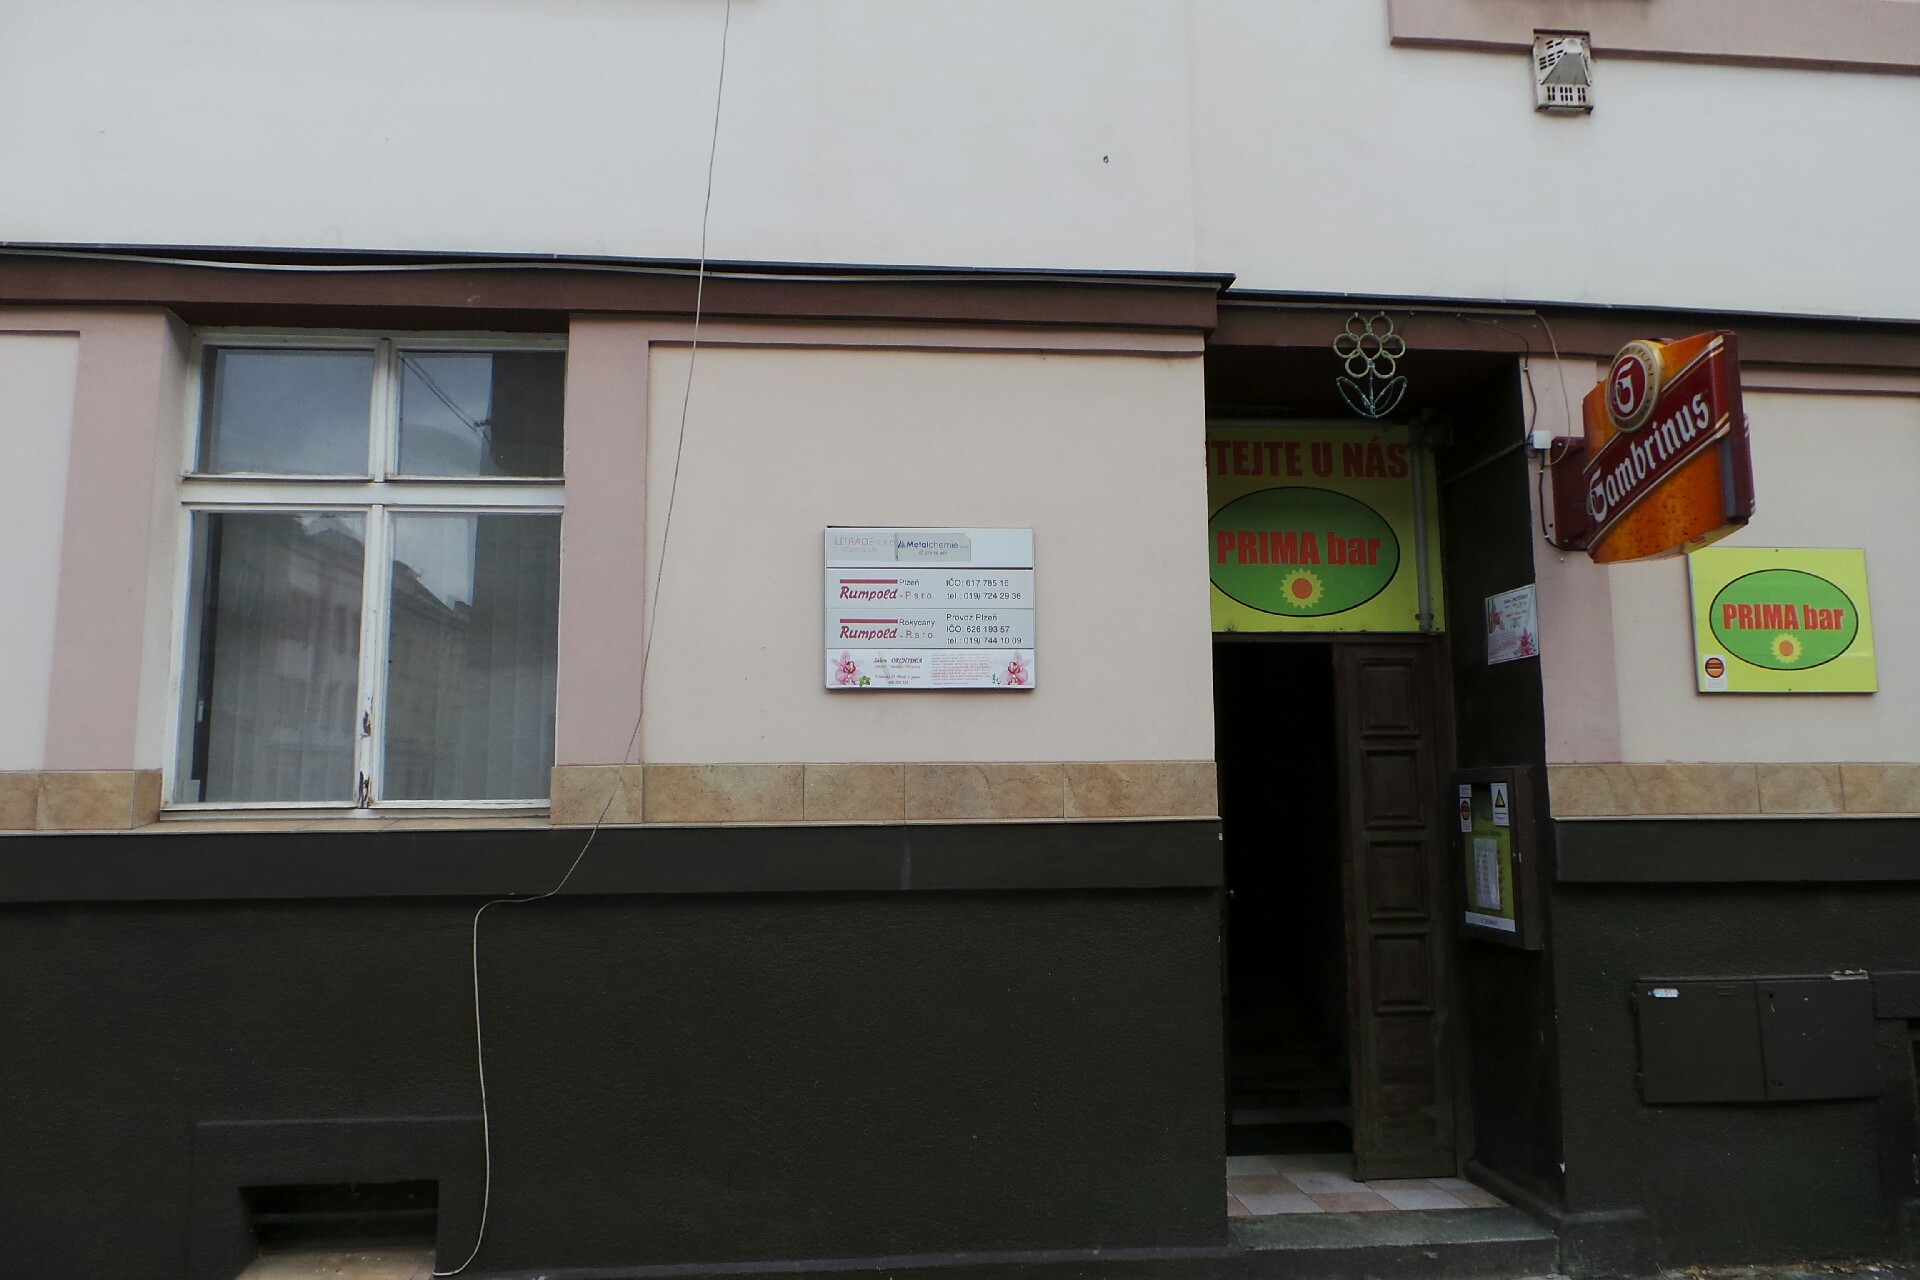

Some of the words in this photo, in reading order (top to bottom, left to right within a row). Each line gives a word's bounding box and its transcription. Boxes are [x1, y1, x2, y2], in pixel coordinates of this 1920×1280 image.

[1207, 440, 1303, 477] TEJTE
[1310, 442, 1334, 478] U
[1342, 436, 1409, 479] NÁS
[1587, 393, 1710, 523] Gambrinus
[906, 541, 959, 549] Metalchemie
[1217, 531, 1320, 565] PRIMA
[1327, 532, 1382, 565] bar
[840, 586, 898, 601] Rumpold
[899, 619, 936, 628] Rokycany
[946, 613, 974, 621] Provoz
[975, 613, 998, 621] Plzeň
[1723, 603, 1799, 630] PRIMA
[1803, 604, 1844, 630] bar
[840, 625, 898, 641] Rumpold
